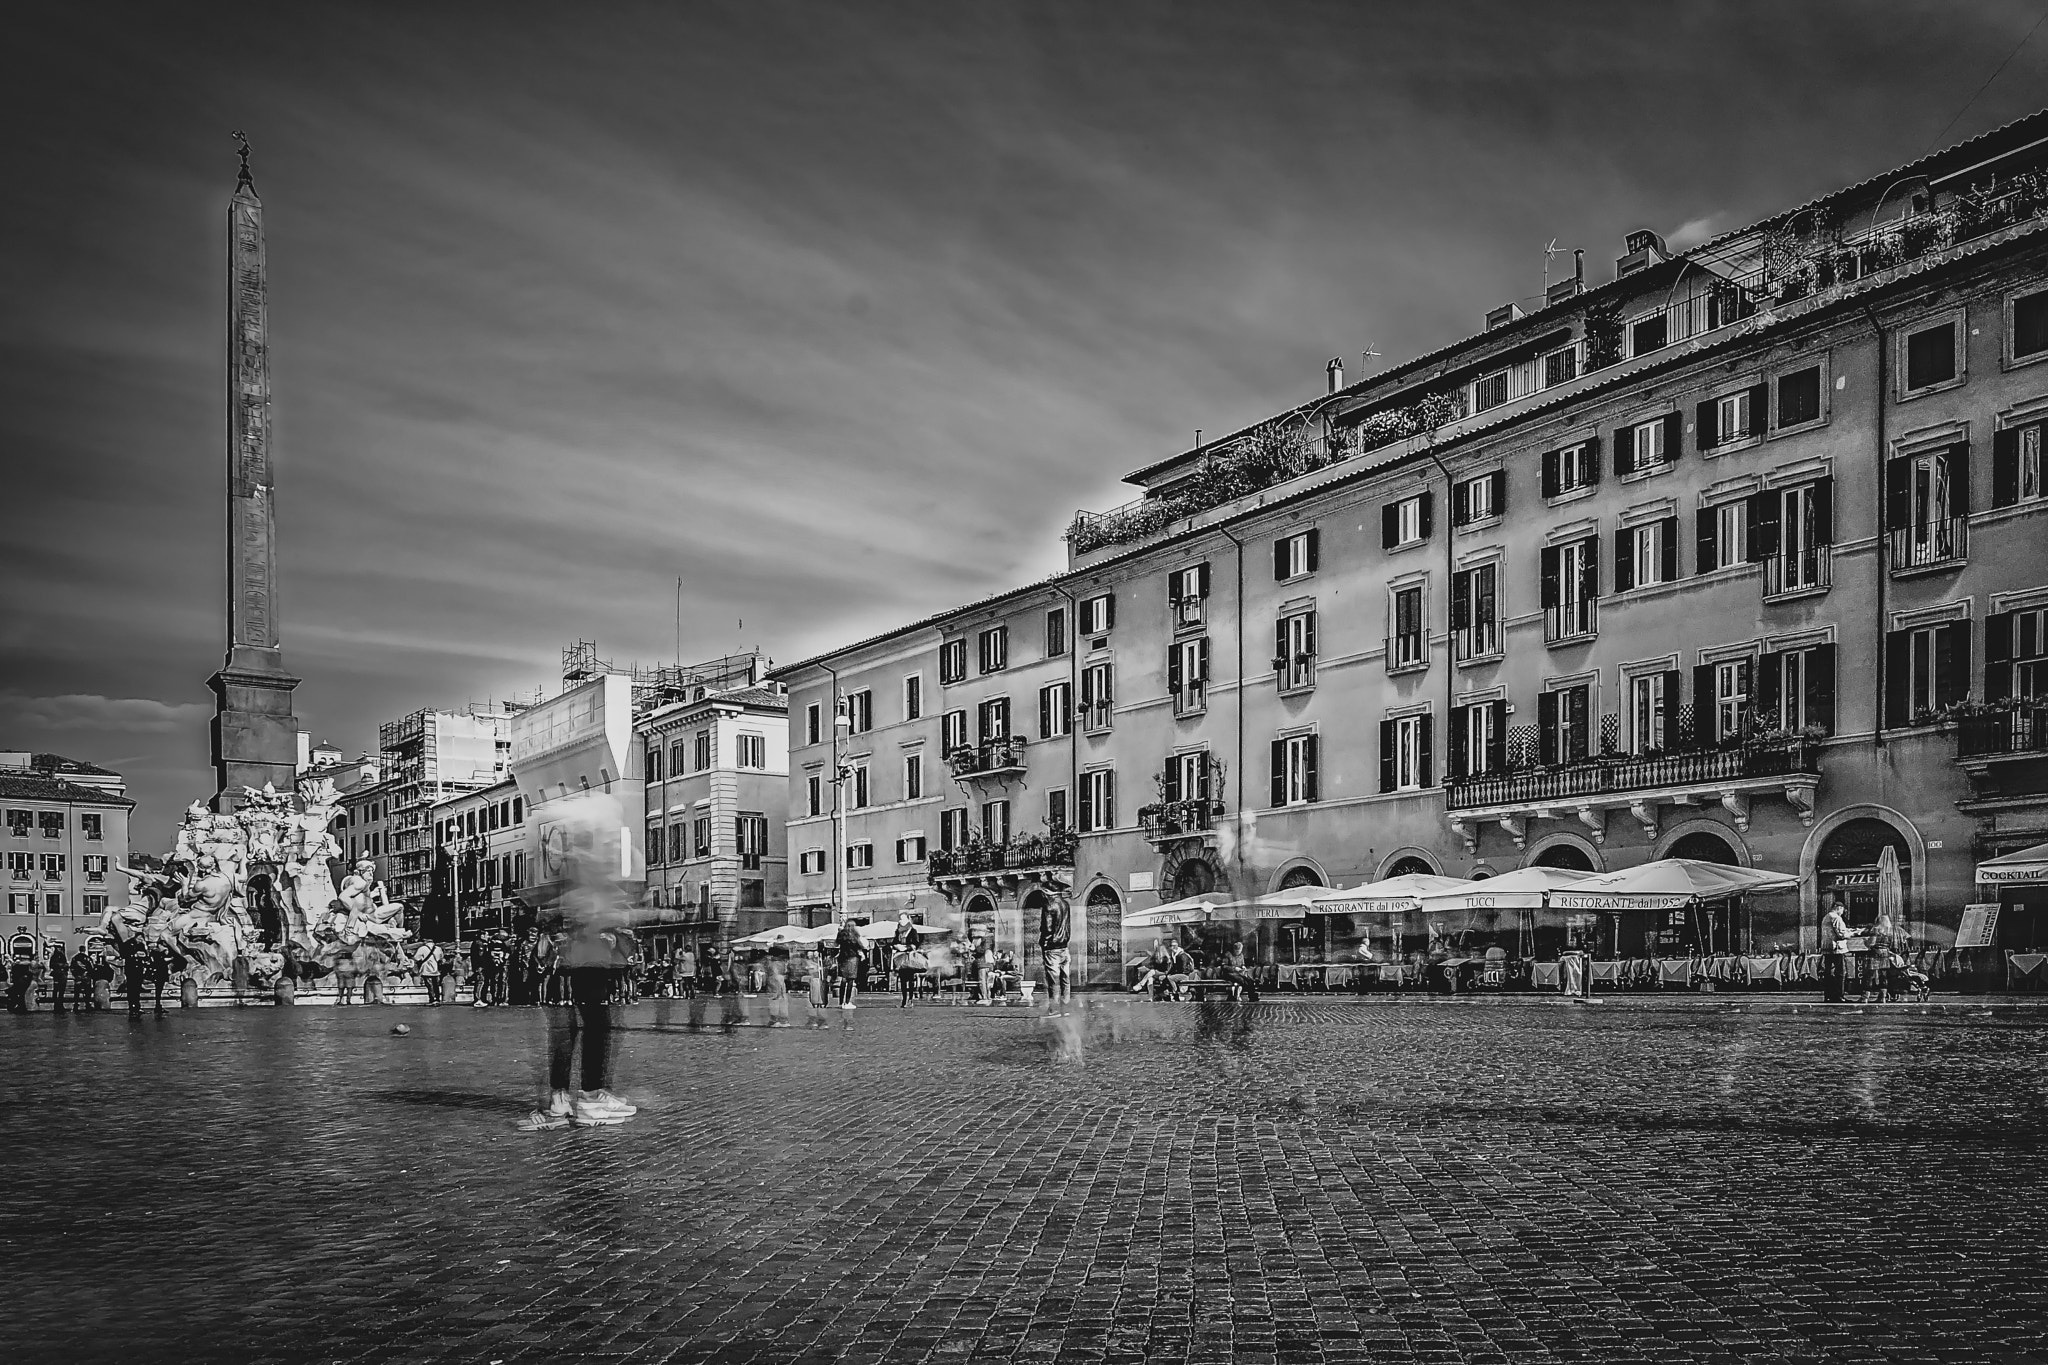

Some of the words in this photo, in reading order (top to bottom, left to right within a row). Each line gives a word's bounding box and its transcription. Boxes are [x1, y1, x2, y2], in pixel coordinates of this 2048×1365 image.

[1981, 871, 2042, 880] COCKTAIL
[1319, 902, 1374, 912] RISTORANTE
[1376, 901, 1388, 911] dal
[1391, 901, 1410, 911] 1952
[1465, 898, 1495, 907] TUCCI
[1560, 897, 1635, 908] RISTORANTE
[1637, 898, 1652, 909] dal
[1656, 898, 1681, 908] 1952
[1149, 914, 1182, 924] PIZZERIA
